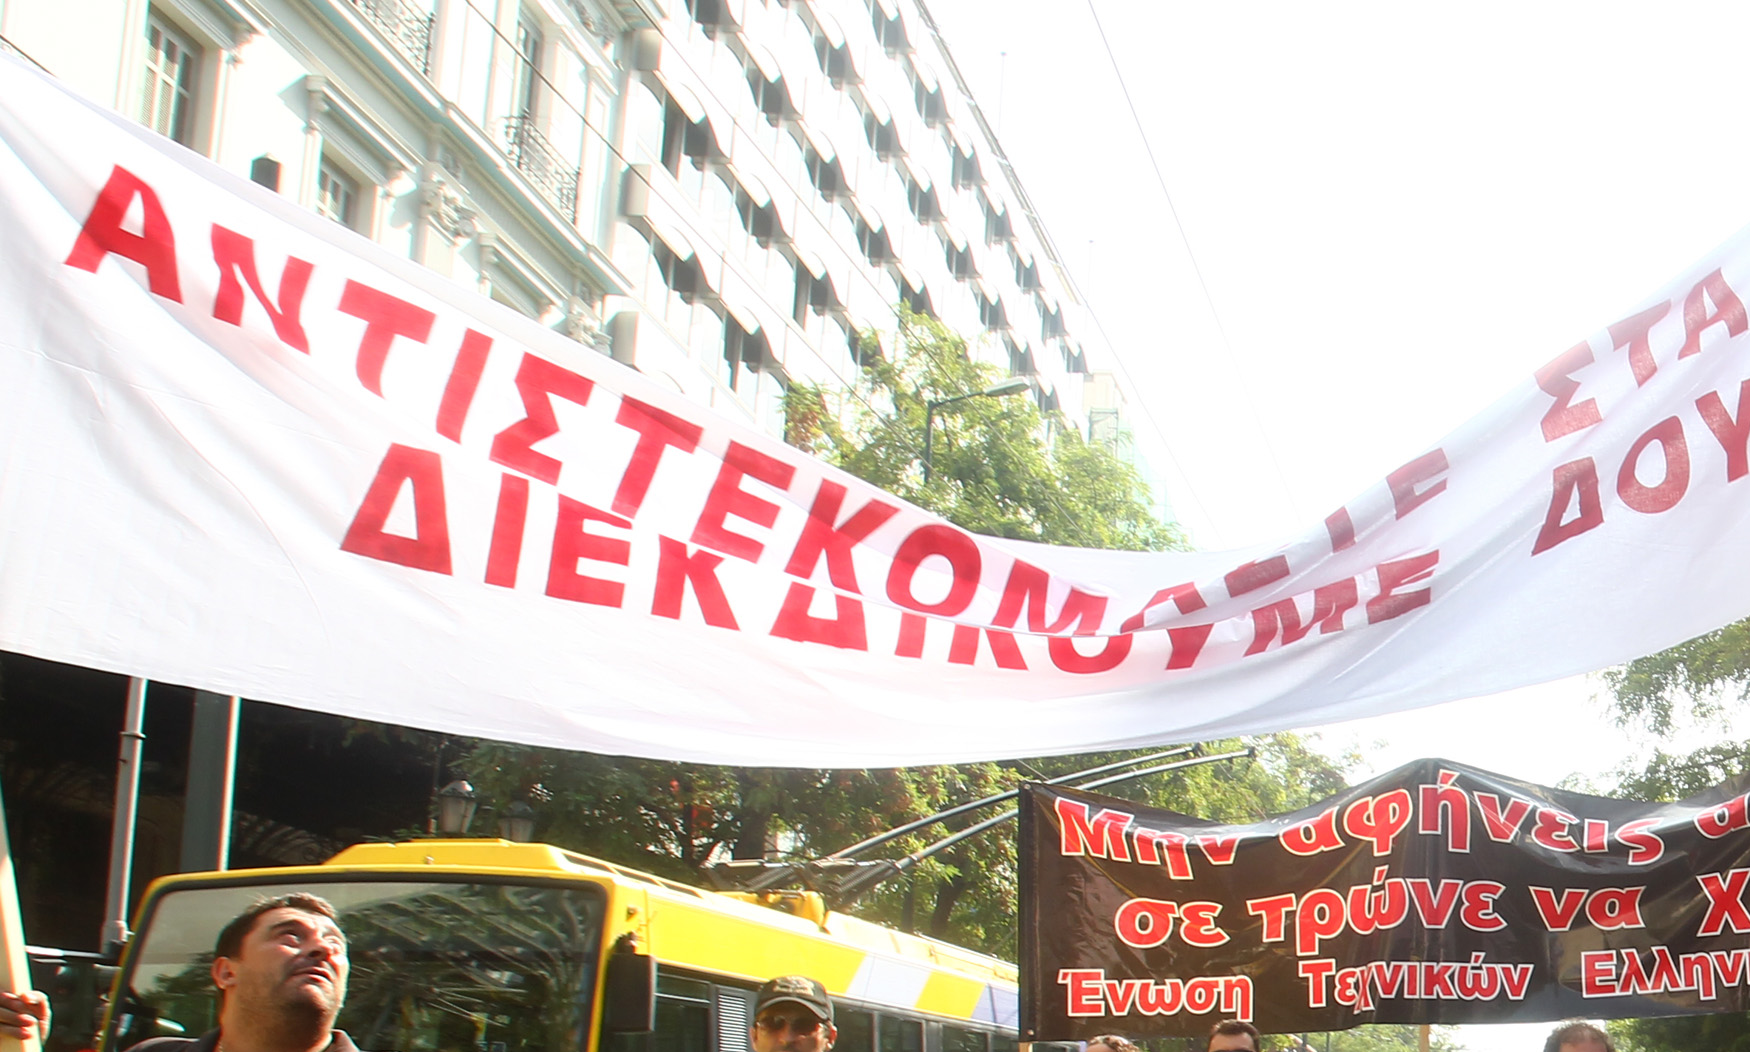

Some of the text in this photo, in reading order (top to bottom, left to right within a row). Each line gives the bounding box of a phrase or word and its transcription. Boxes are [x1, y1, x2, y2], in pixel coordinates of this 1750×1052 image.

[64, 164, 1449, 634] ΑΝΤΙΣΤΕΚΟΜΕ
[1534, 266, 1749, 442] ΣΤΑ
[1054, 796, 1241, 881] Μην
[1279, 768, 1666, 867] αφήνεις
[1115, 898, 1231, 949] σε
[1247, 864, 1508, 956] τρώνε
[1528, 886, 1647, 933] να
[1057, 968, 1254, 1023] Ένωση
[1298, 952, 1534, 1016] Τεχνικών
